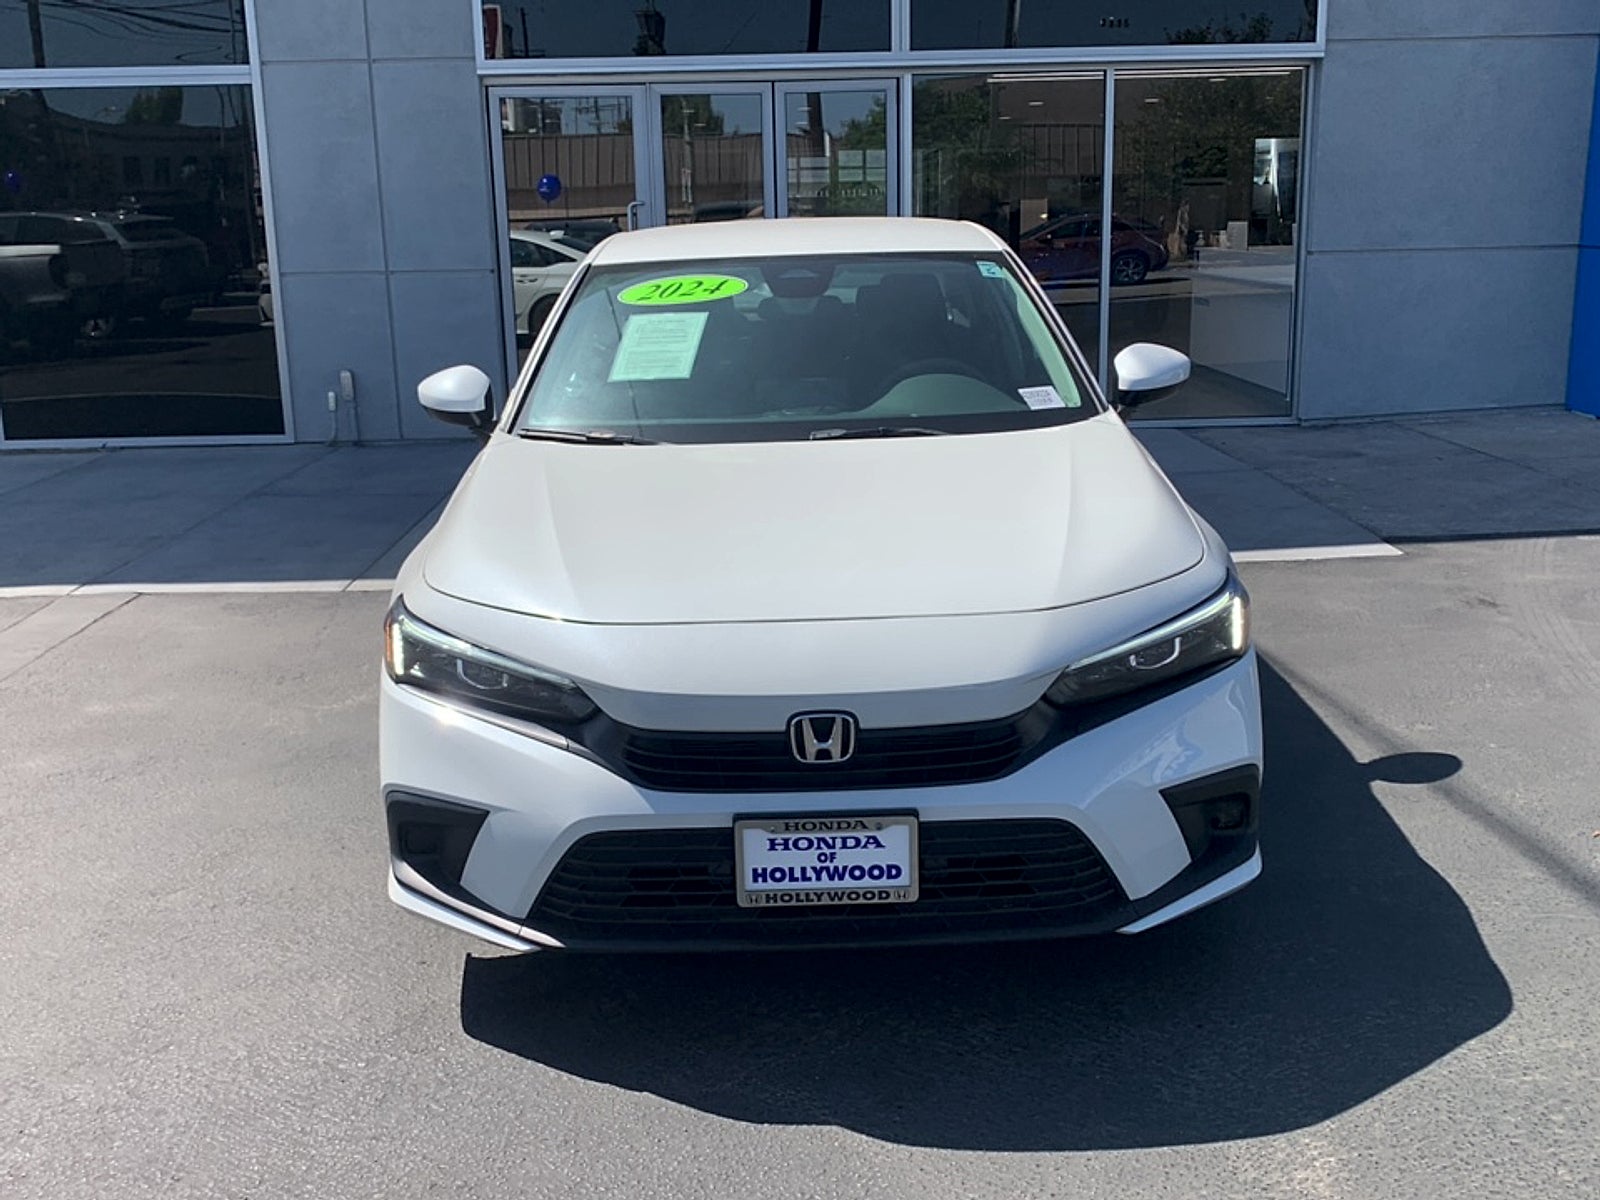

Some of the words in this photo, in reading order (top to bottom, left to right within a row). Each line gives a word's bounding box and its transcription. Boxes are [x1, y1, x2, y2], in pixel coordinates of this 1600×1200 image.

[637, 279, 730, 301] 2024
[784, 820, 869, 832] HONDA
[767, 835, 886, 851] HONDA
[817, 852, 837, 863] OF
[752, 864, 902, 883] HOLLYWOOD
[765, 890, 891, 904] HOLLYWOOD
